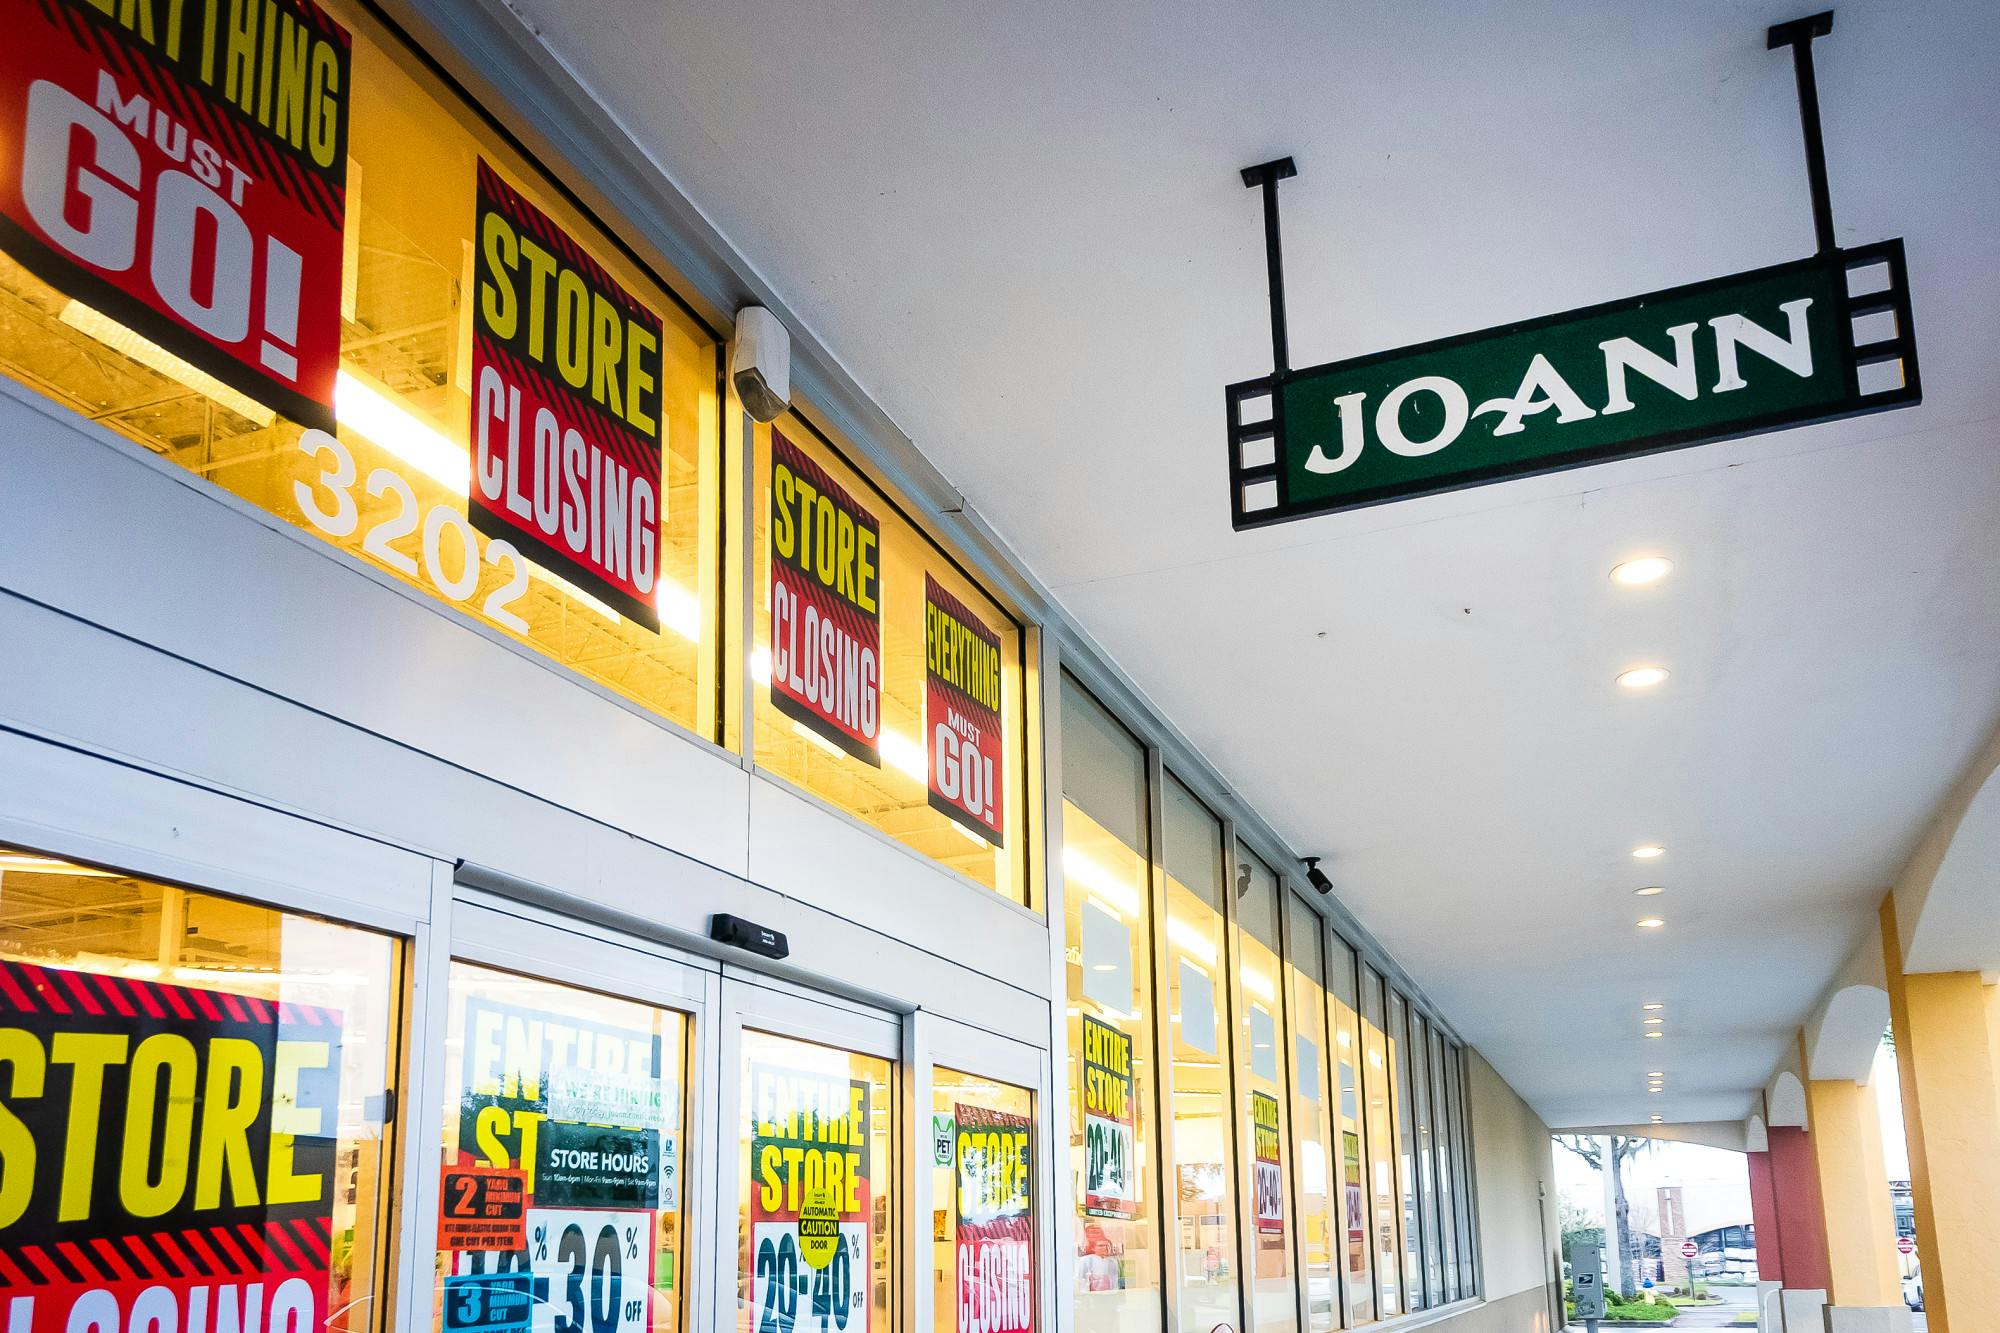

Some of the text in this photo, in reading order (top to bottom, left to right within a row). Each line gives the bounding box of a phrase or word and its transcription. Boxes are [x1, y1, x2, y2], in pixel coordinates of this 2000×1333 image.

[96, 69, 253, 207] MUST
[22, 79, 302, 382] GO!
[481, 212, 656, 437] STORE
[477, 365, 654, 594] CLOSING
[293, 428, 530, 635] 3202
[774, 463, 877, 614] STORE
[774, 580, 877, 740] CLOSING
[927, 600, 999, 713] EVERYTHING
[947, 706, 981, 748] MUST
[935, 722, 994, 826] GO!
[1085, 1019, 1129, 1077] ENTIRE
[1087, 1065, 1129, 1119] STORE
[550, 1148, 599, 1170] STORE
[601, 1153, 649, 1174] HOURS
[936, 1138, 951, 1154] PET
[454, 1177, 478, 1216] 2
[761, 1144, 861, 1213] STORE
[957, 1132, 1029, 1217] STORE
[485, 1204, 503, 1216] CUT
[801, 1219, 837, 1236] CAUTION
[803, 1206, 836, 1218] AUTOMATIC
[810, 1239, 828, 1250] DOOR
[458, 1280, 515, 1324] 3 YARD
[489, 1293, 528, 1308] MINIMUM
[490, 1308, 508, 1321] CUT
[625, 1301, 642, 1322] OFF
[853, 1292, 864, 1308] OFF
[958, 1242, 1031, 1333] CLOSING
